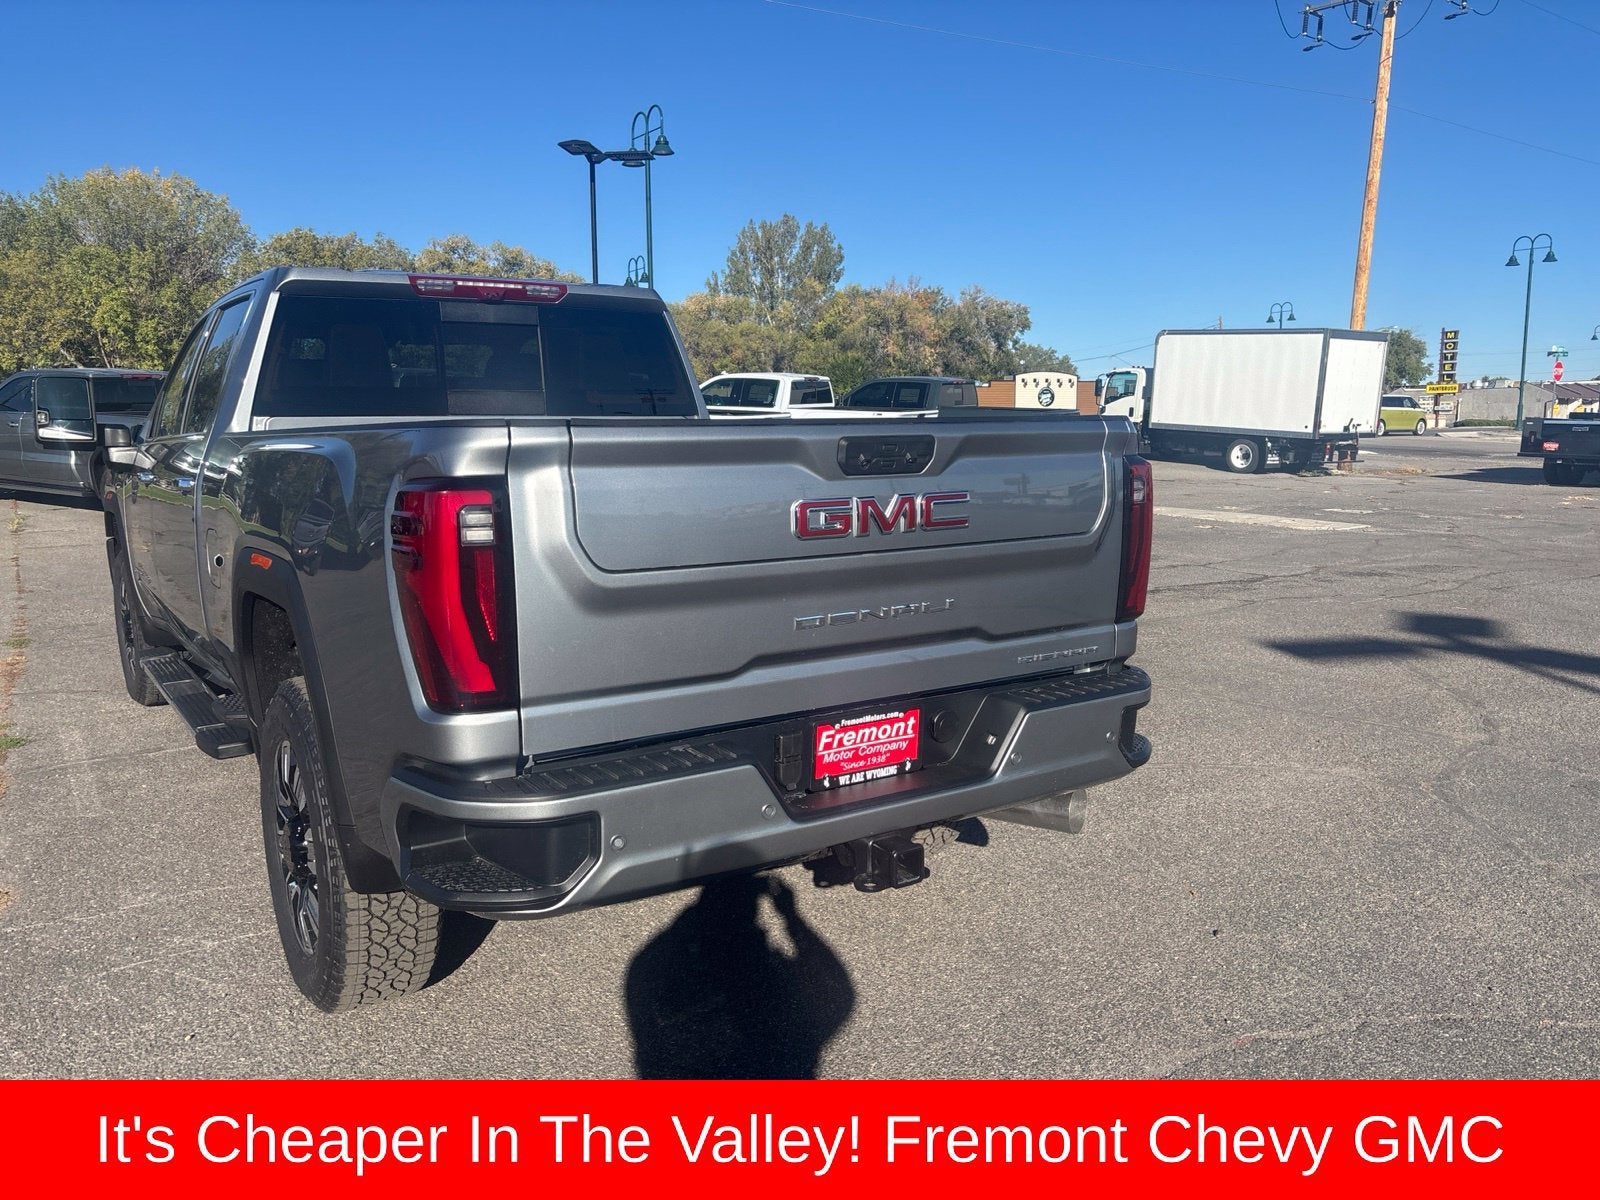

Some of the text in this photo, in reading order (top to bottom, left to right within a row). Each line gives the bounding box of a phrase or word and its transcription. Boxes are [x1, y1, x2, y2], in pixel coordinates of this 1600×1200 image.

[1443, 331, 1456, 382] MOTEL
[790, 490, 970, 541] GMC
[793, 598, 955, 631] DENALI
[818, 716, 916, 751] Fremont
[841, 711, 899, 727] FremontMotors.com
[823, 739, 909, 764] Motor Company
[839, 765, 898, 786] WE ARE WYOMING
